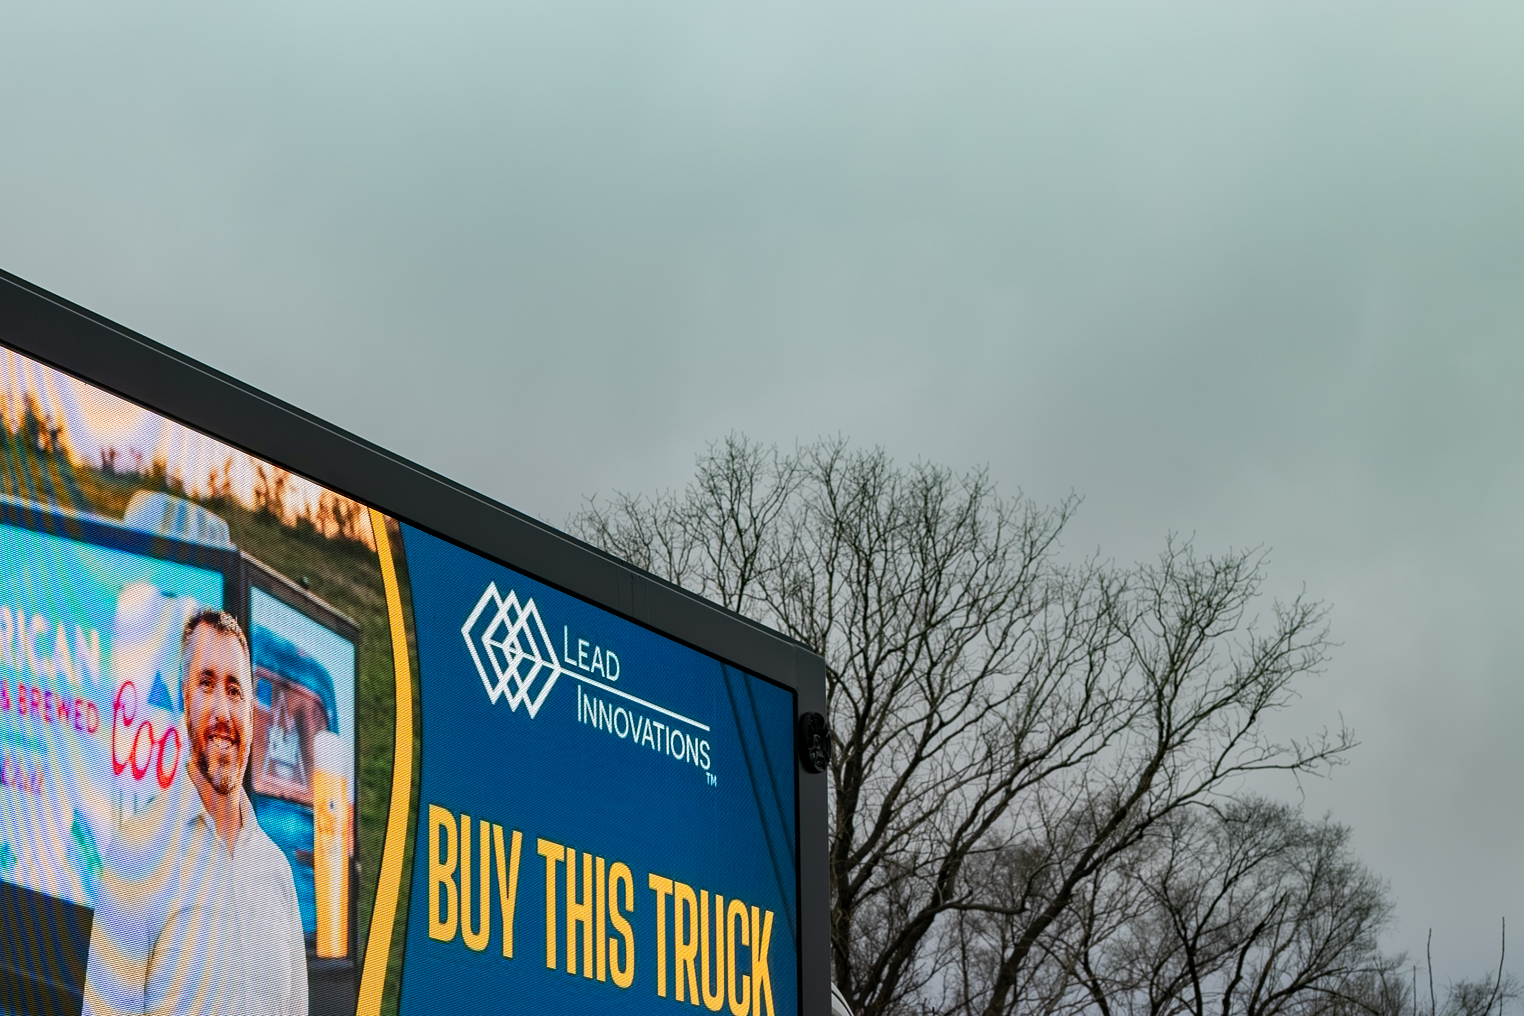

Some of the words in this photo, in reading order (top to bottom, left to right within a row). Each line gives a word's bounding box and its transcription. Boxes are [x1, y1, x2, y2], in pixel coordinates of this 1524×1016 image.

[18, 681, 100, 734] BREWED
[428, 803, 523, 960] BUY
[537, 837, 635, 990] THIS
